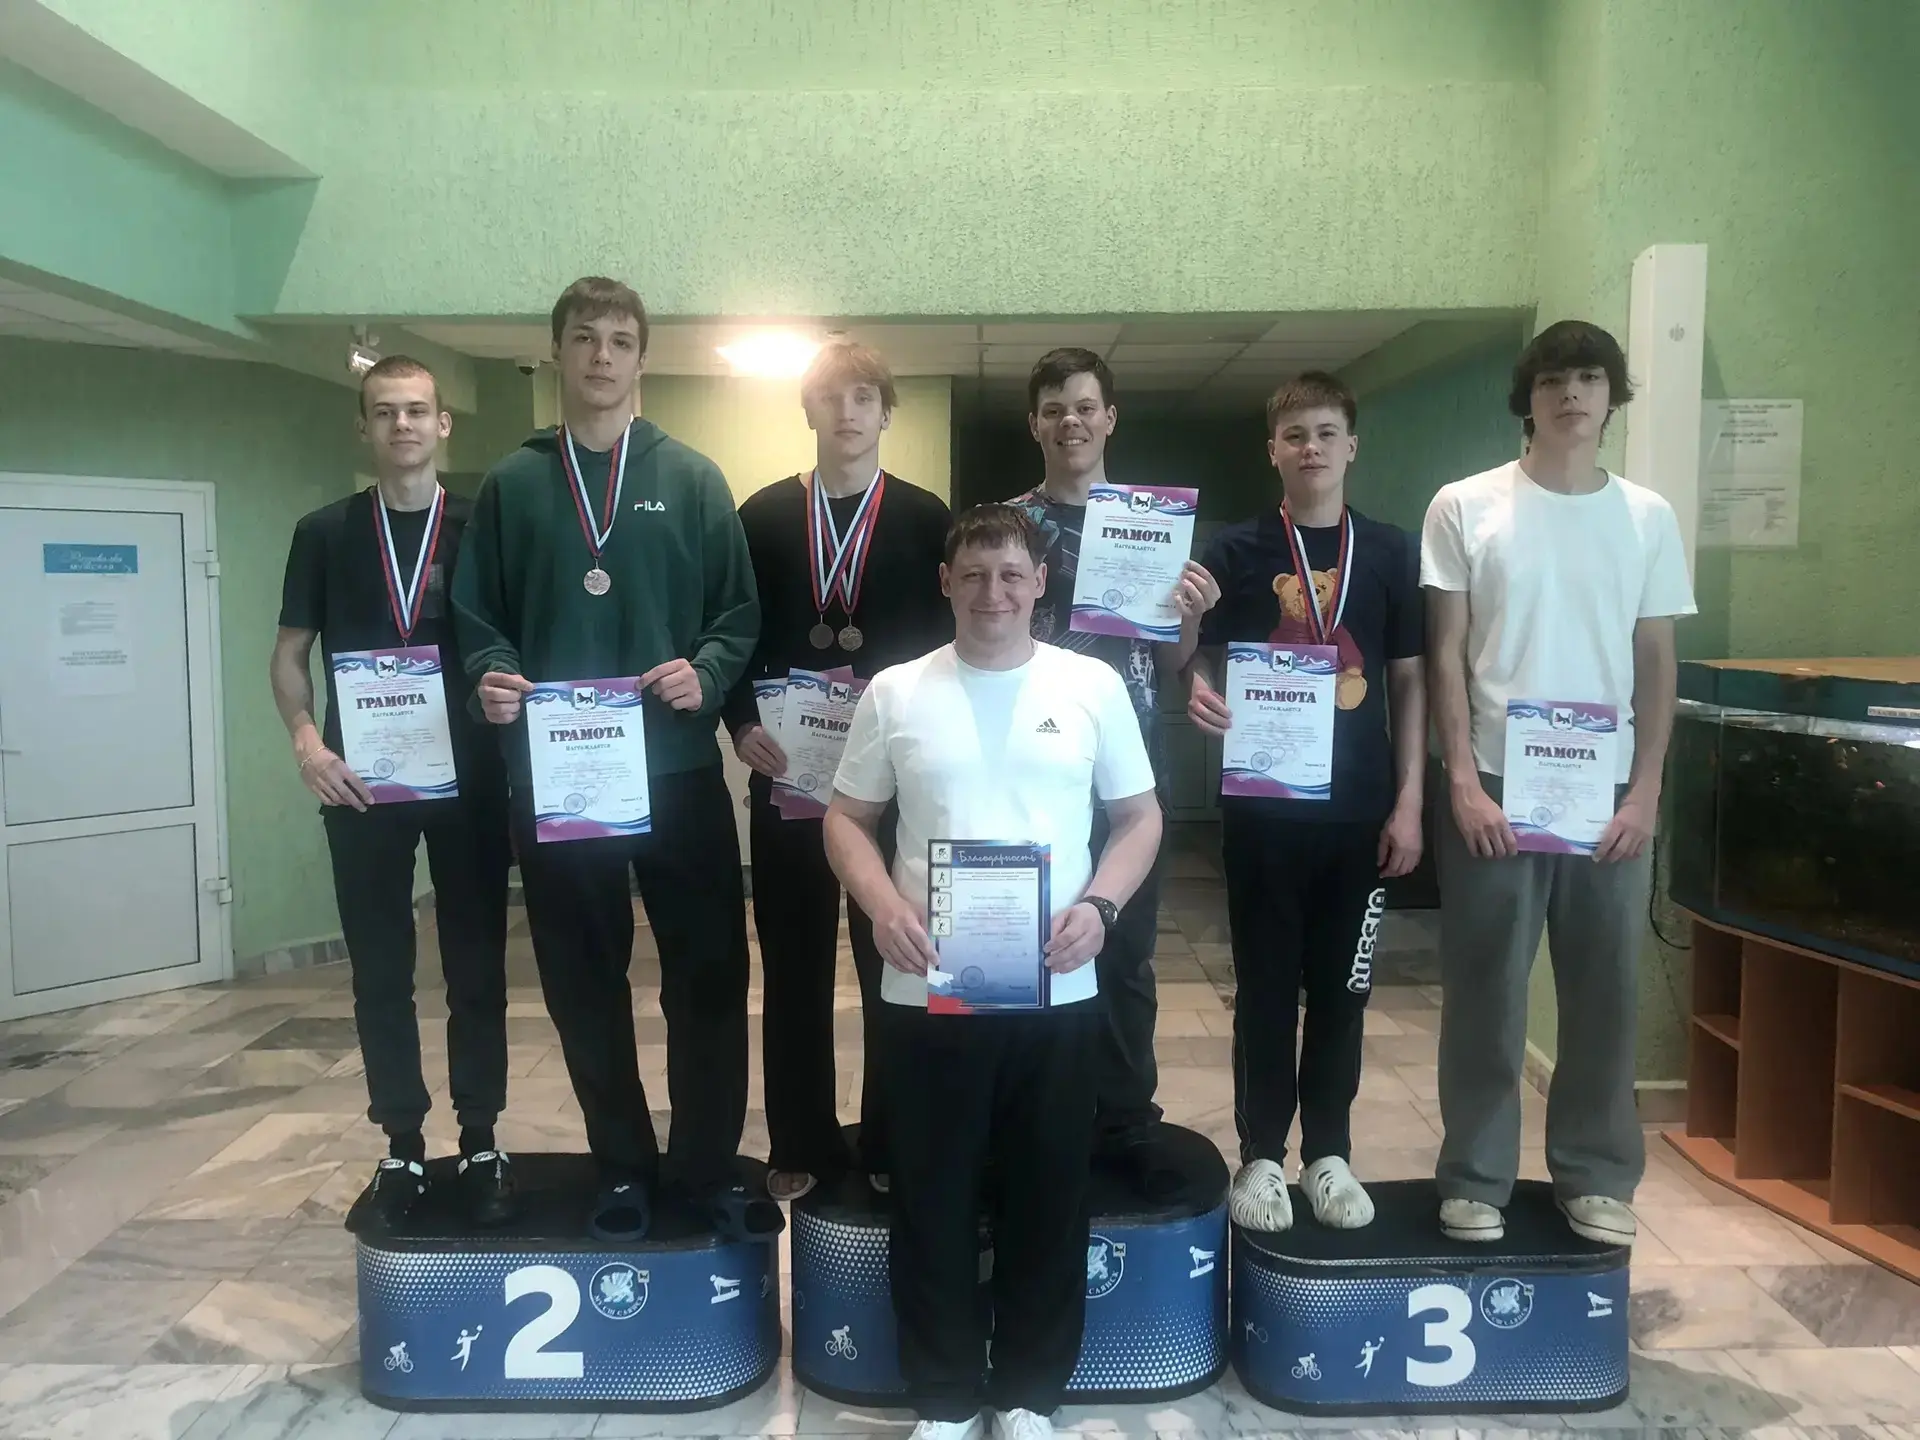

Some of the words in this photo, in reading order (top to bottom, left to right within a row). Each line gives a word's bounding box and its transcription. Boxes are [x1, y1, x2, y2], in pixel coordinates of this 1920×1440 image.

[633, 500, 666, 511] FILA
[1101, 527, 1172, 544] ГРАМОТА
[356, 693, 428, 710] ГРАМОТА
[1245, 689, 1317, 704] ГРАМОТА
[549, 726, 626, 743] ГРАМОТА
[1524, 745, 1597, 761] ГРАМОТА
[957, 850, 1037, 866] Благодарность
[504, 1265, 584, 1379] 2
[1406, 1283, 1477, 1387] 3
